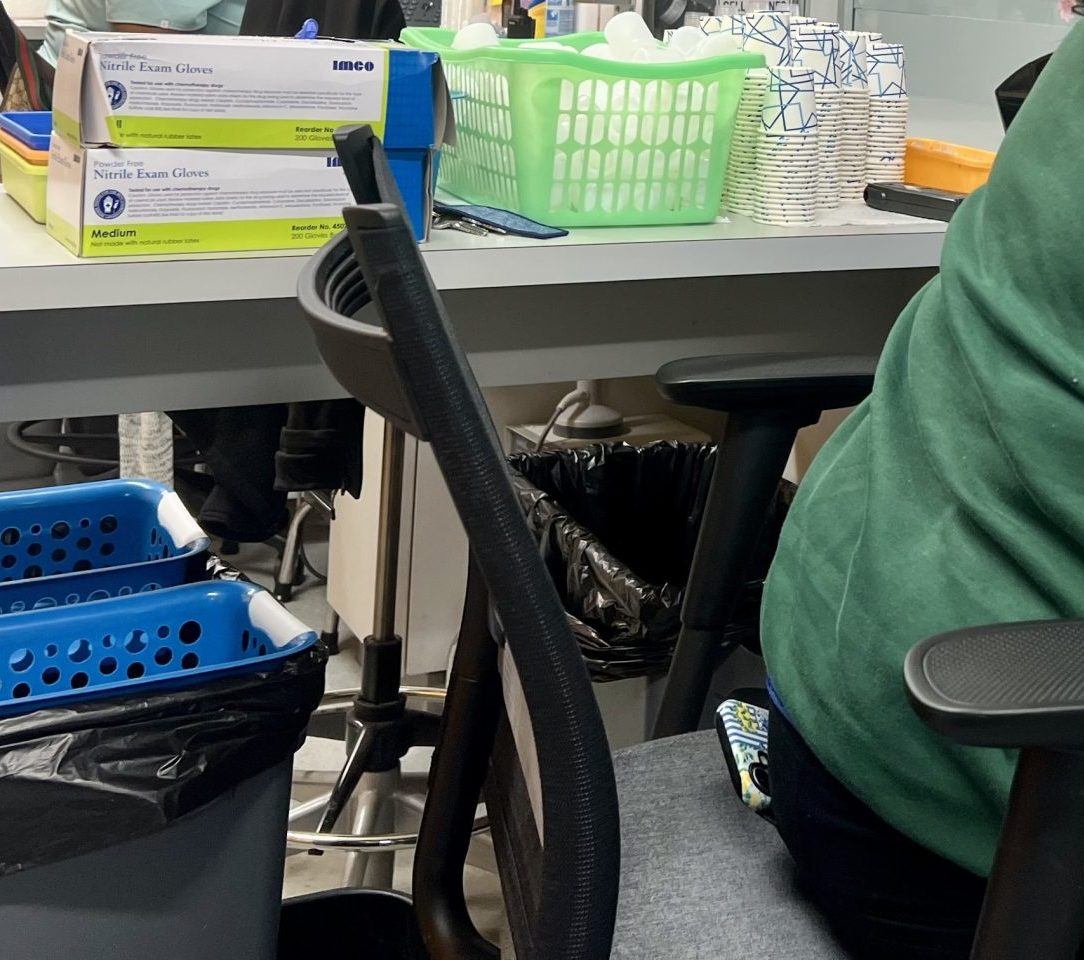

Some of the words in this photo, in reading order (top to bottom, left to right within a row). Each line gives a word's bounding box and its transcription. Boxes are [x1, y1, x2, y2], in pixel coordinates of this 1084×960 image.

[100, 60, 136, 72] Nitrile
[139, 61, 172, 73] Exam
[175, 63, 214, 75] Gloves
[93, 160, 125, 168] Powder
[126, 159, 144, 167] Free
[93, 168, 133, 180] Nitrile
[136, 168, 169, 179] Exam
[172, 167, 209, 178] Gloves
[91, 228, 137, 239] Medium
